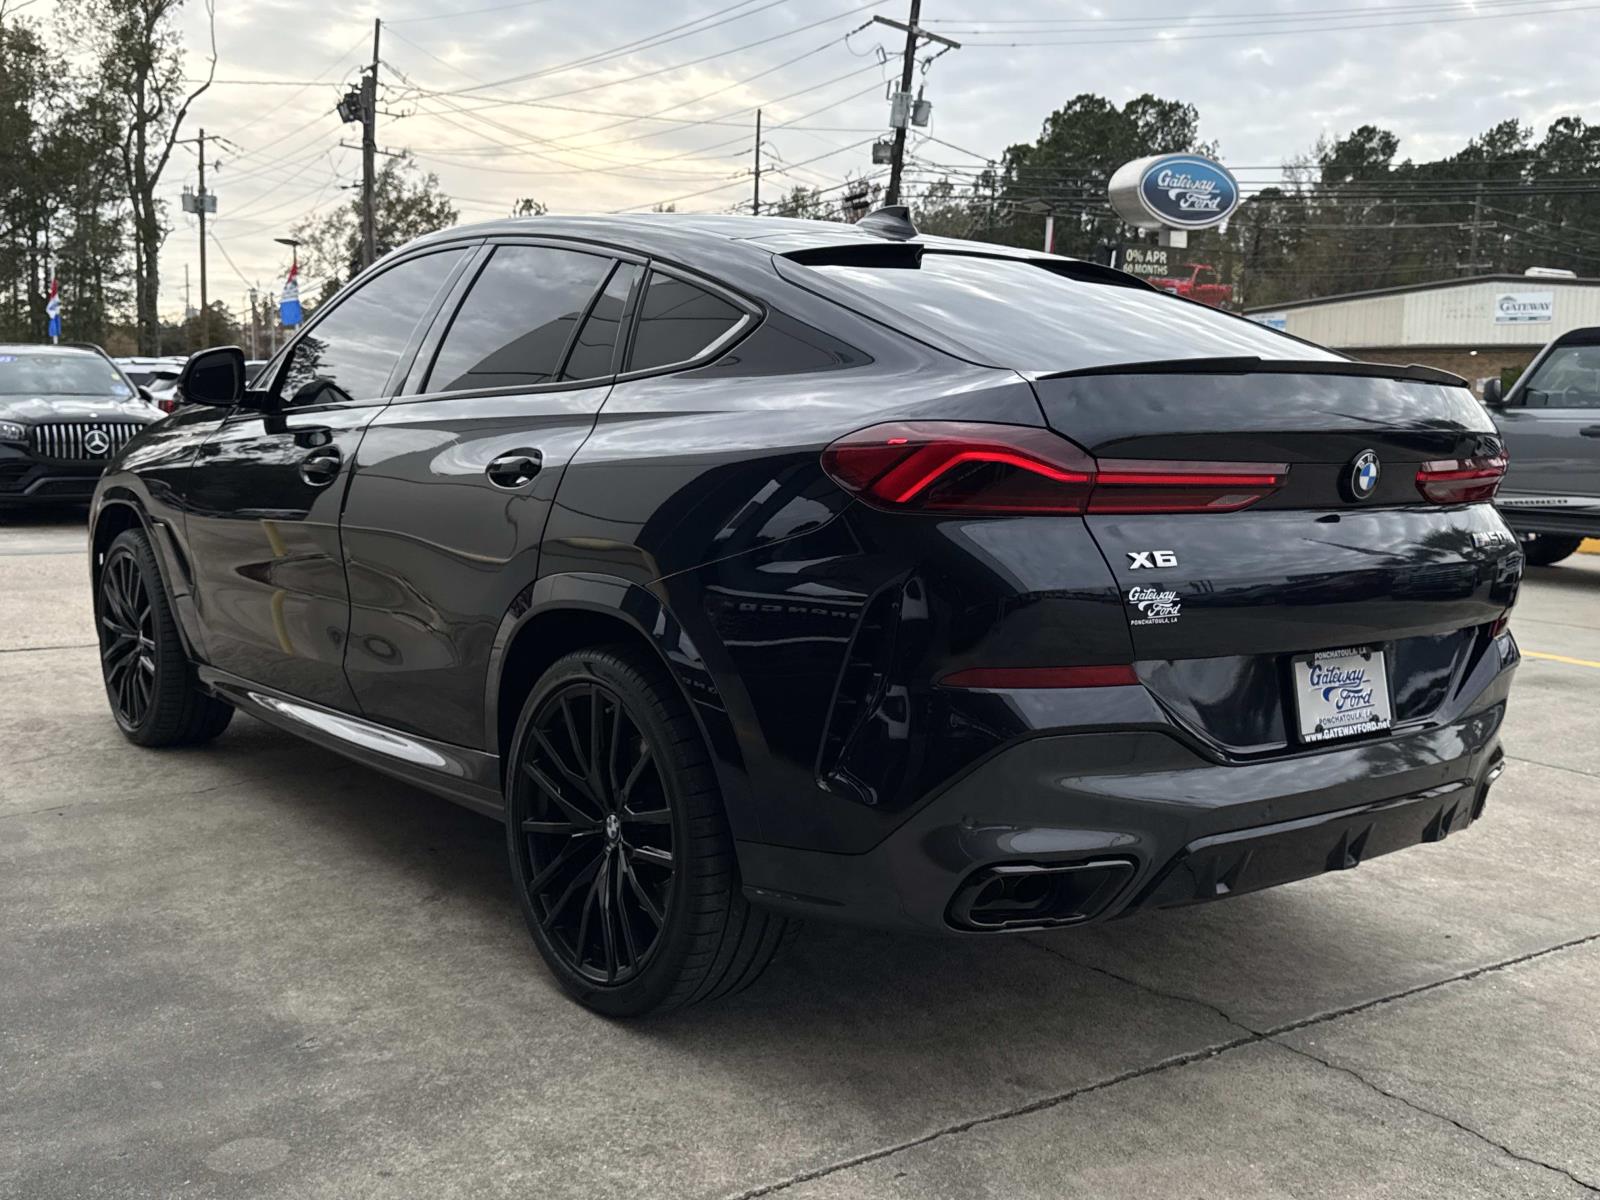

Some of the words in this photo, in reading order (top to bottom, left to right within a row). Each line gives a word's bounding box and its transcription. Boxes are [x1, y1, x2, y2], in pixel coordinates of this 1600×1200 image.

[1157, 169, 1216, 192] Gateway
[1179, 193, 1221, 209] Ford
[1126, 249, 1144, 262] 0%
[1145, 250, 1168, 264] APR
[1134, 264, 1169, 275] MONTHS
[1499, 301, 1551, 312] GATEWAY
[1126, 550, 1178, 570] X6
[1128, 586, 1177, 602] Gateway
[1147, 602, 1181, 617] Ford
[1310, 664, 1365, 688] Gateway
[1336, 688, 1373, 710] Ford
[1304, 720, 1391, 742] www.GATEWAYFORD.net
